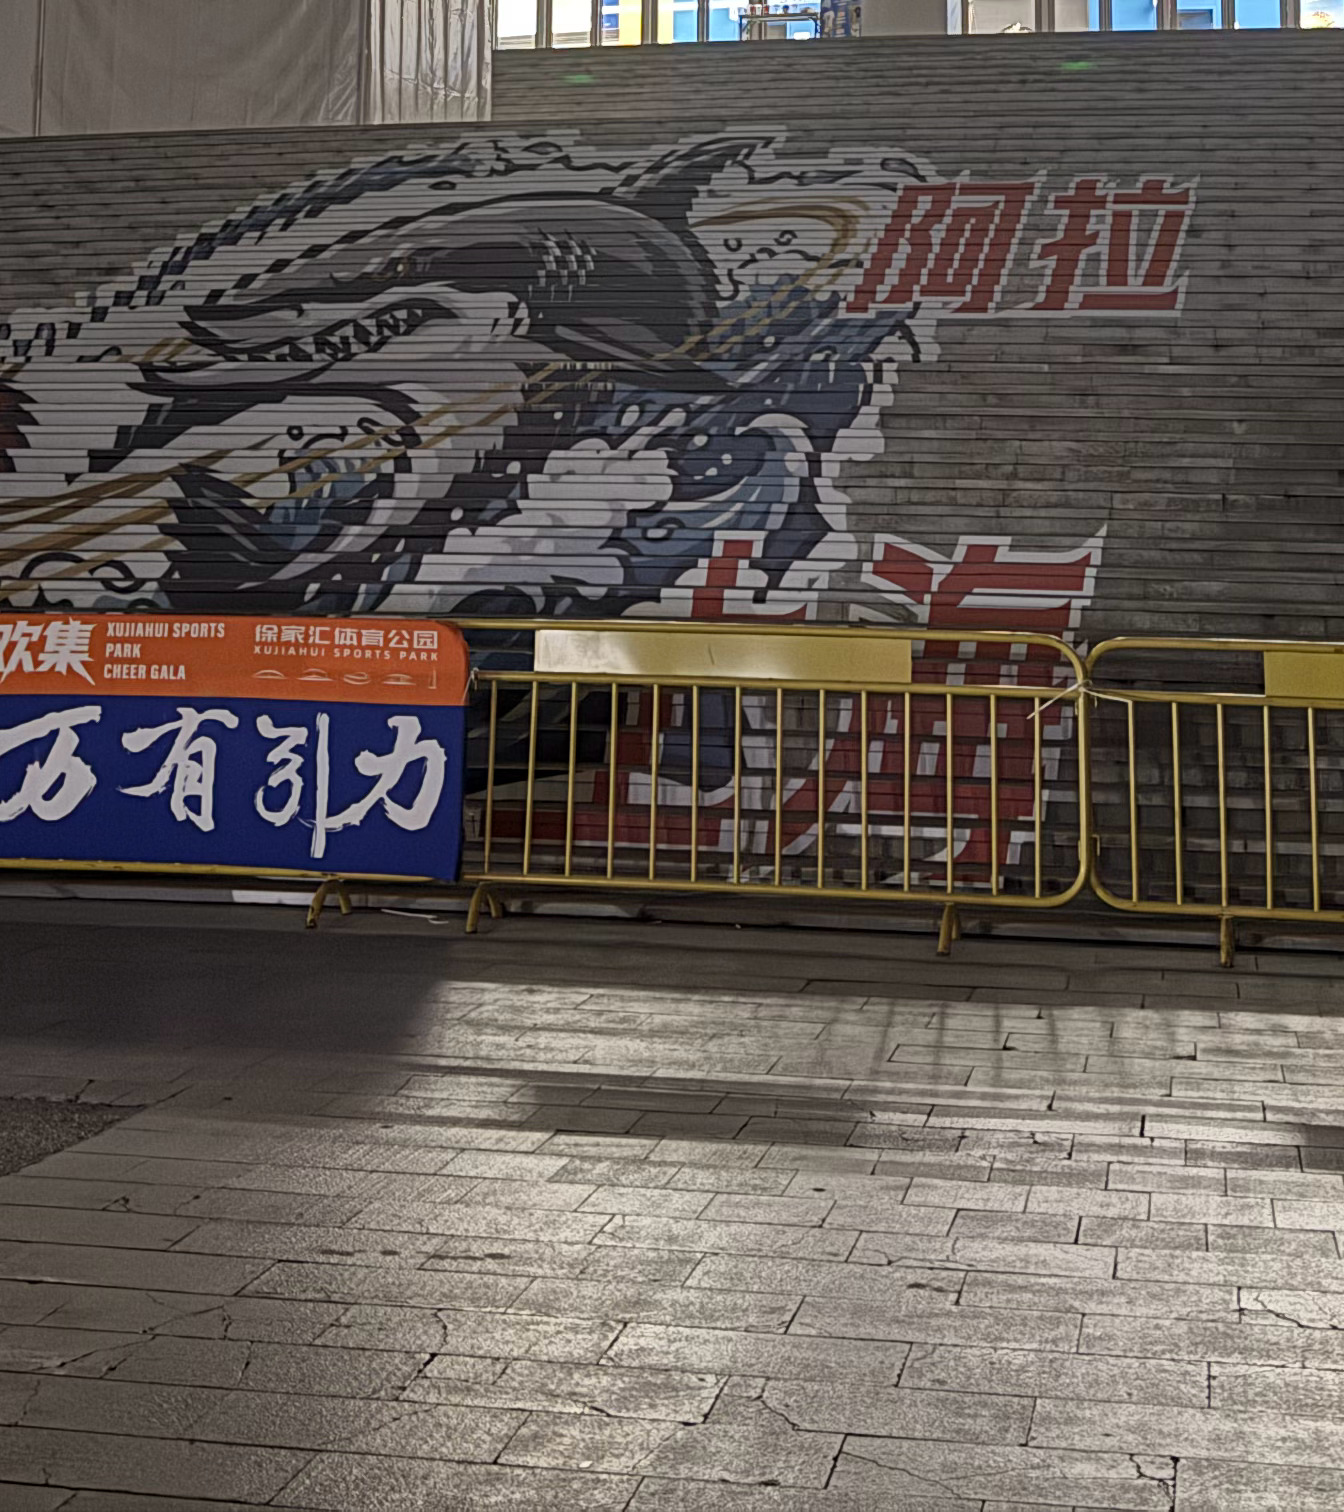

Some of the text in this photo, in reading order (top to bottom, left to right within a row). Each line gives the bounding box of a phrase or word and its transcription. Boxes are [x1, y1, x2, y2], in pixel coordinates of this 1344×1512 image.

[841, 169, 1201, 319] 阿拉
[106, 622, 225, 639] XUJIAHUI SPORTS
[255, 624, 439, 650] 徐家汇体育公园
[105, 642, 141, 659] PARK
[253, 645, 439, 662] XUJIAHUI SPORTS PARK
[103, 664, 186, 681] CHEER GALA
